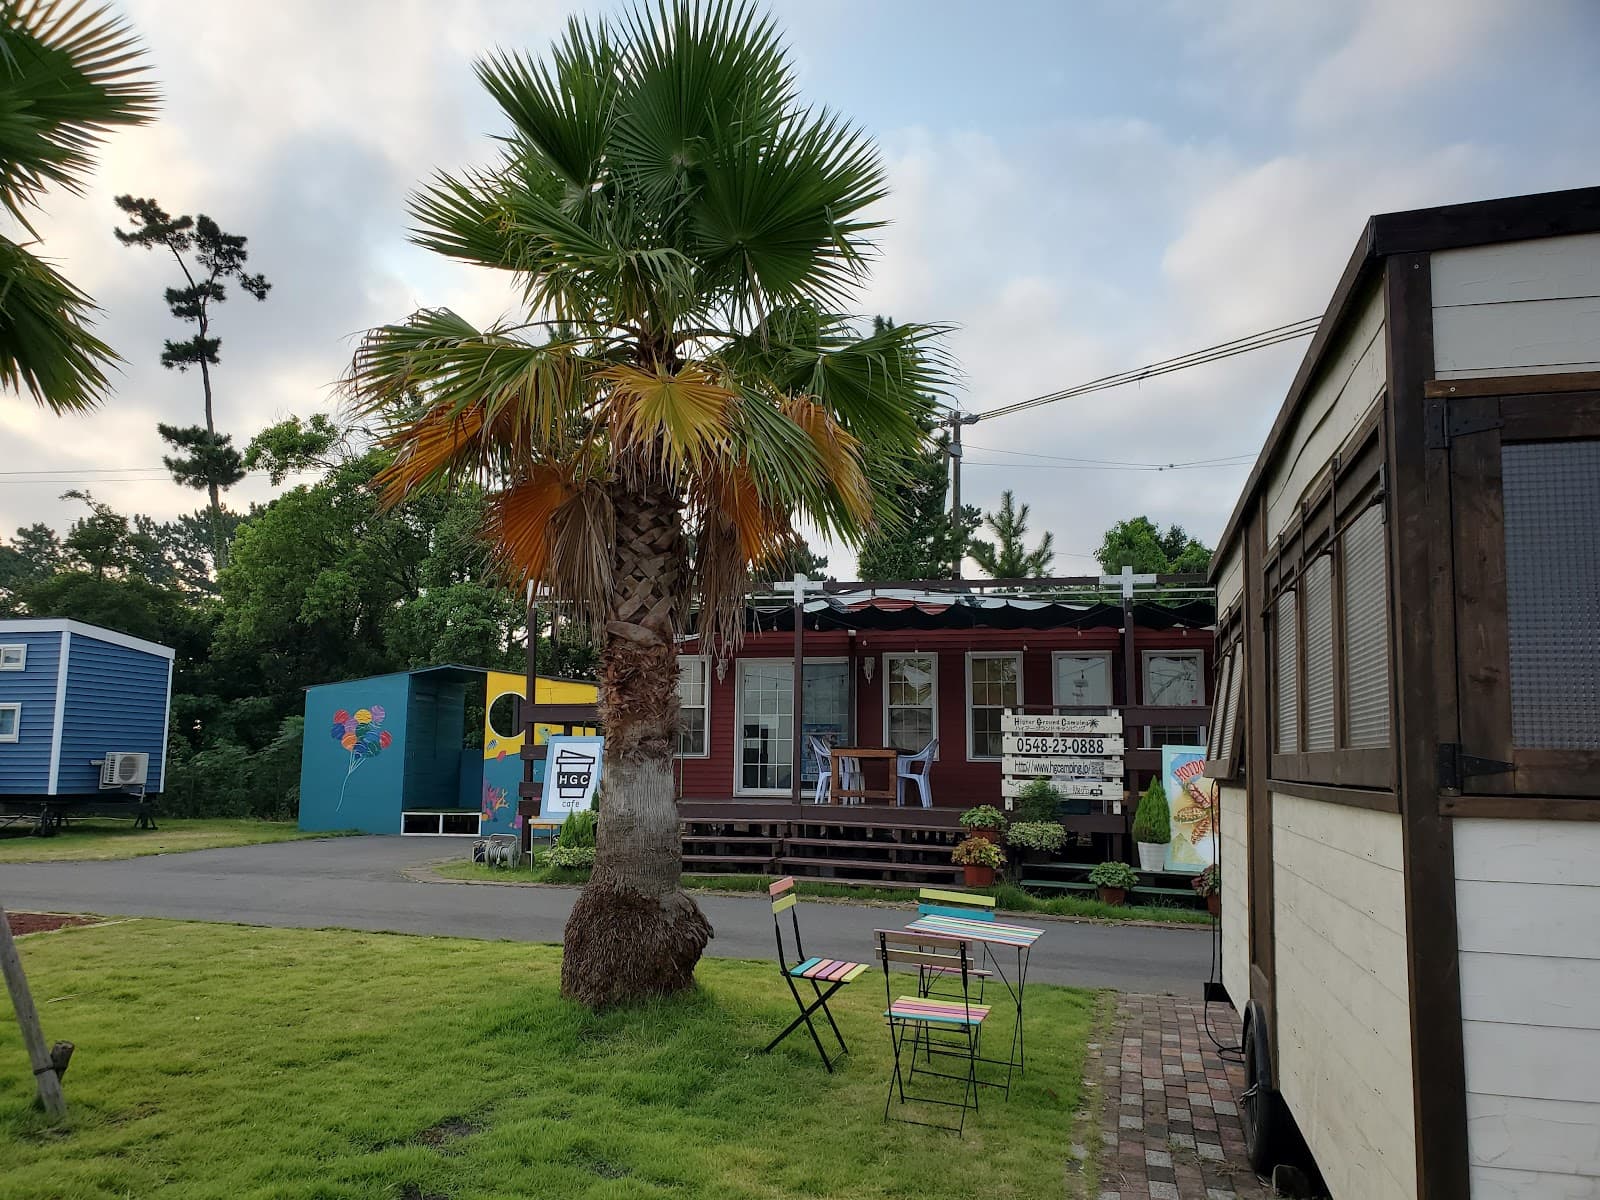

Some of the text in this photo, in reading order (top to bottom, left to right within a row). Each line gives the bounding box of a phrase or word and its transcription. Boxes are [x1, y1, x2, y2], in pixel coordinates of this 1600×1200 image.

[1036, 717, 1060, 727] Ground
[1017, 738, 1104, 753] 0548-23-0888
[1174, 759, 1205, 781] HOTDO
[559, 774, 589, 785] HGC
[561, 800, 580, 808] cafe
